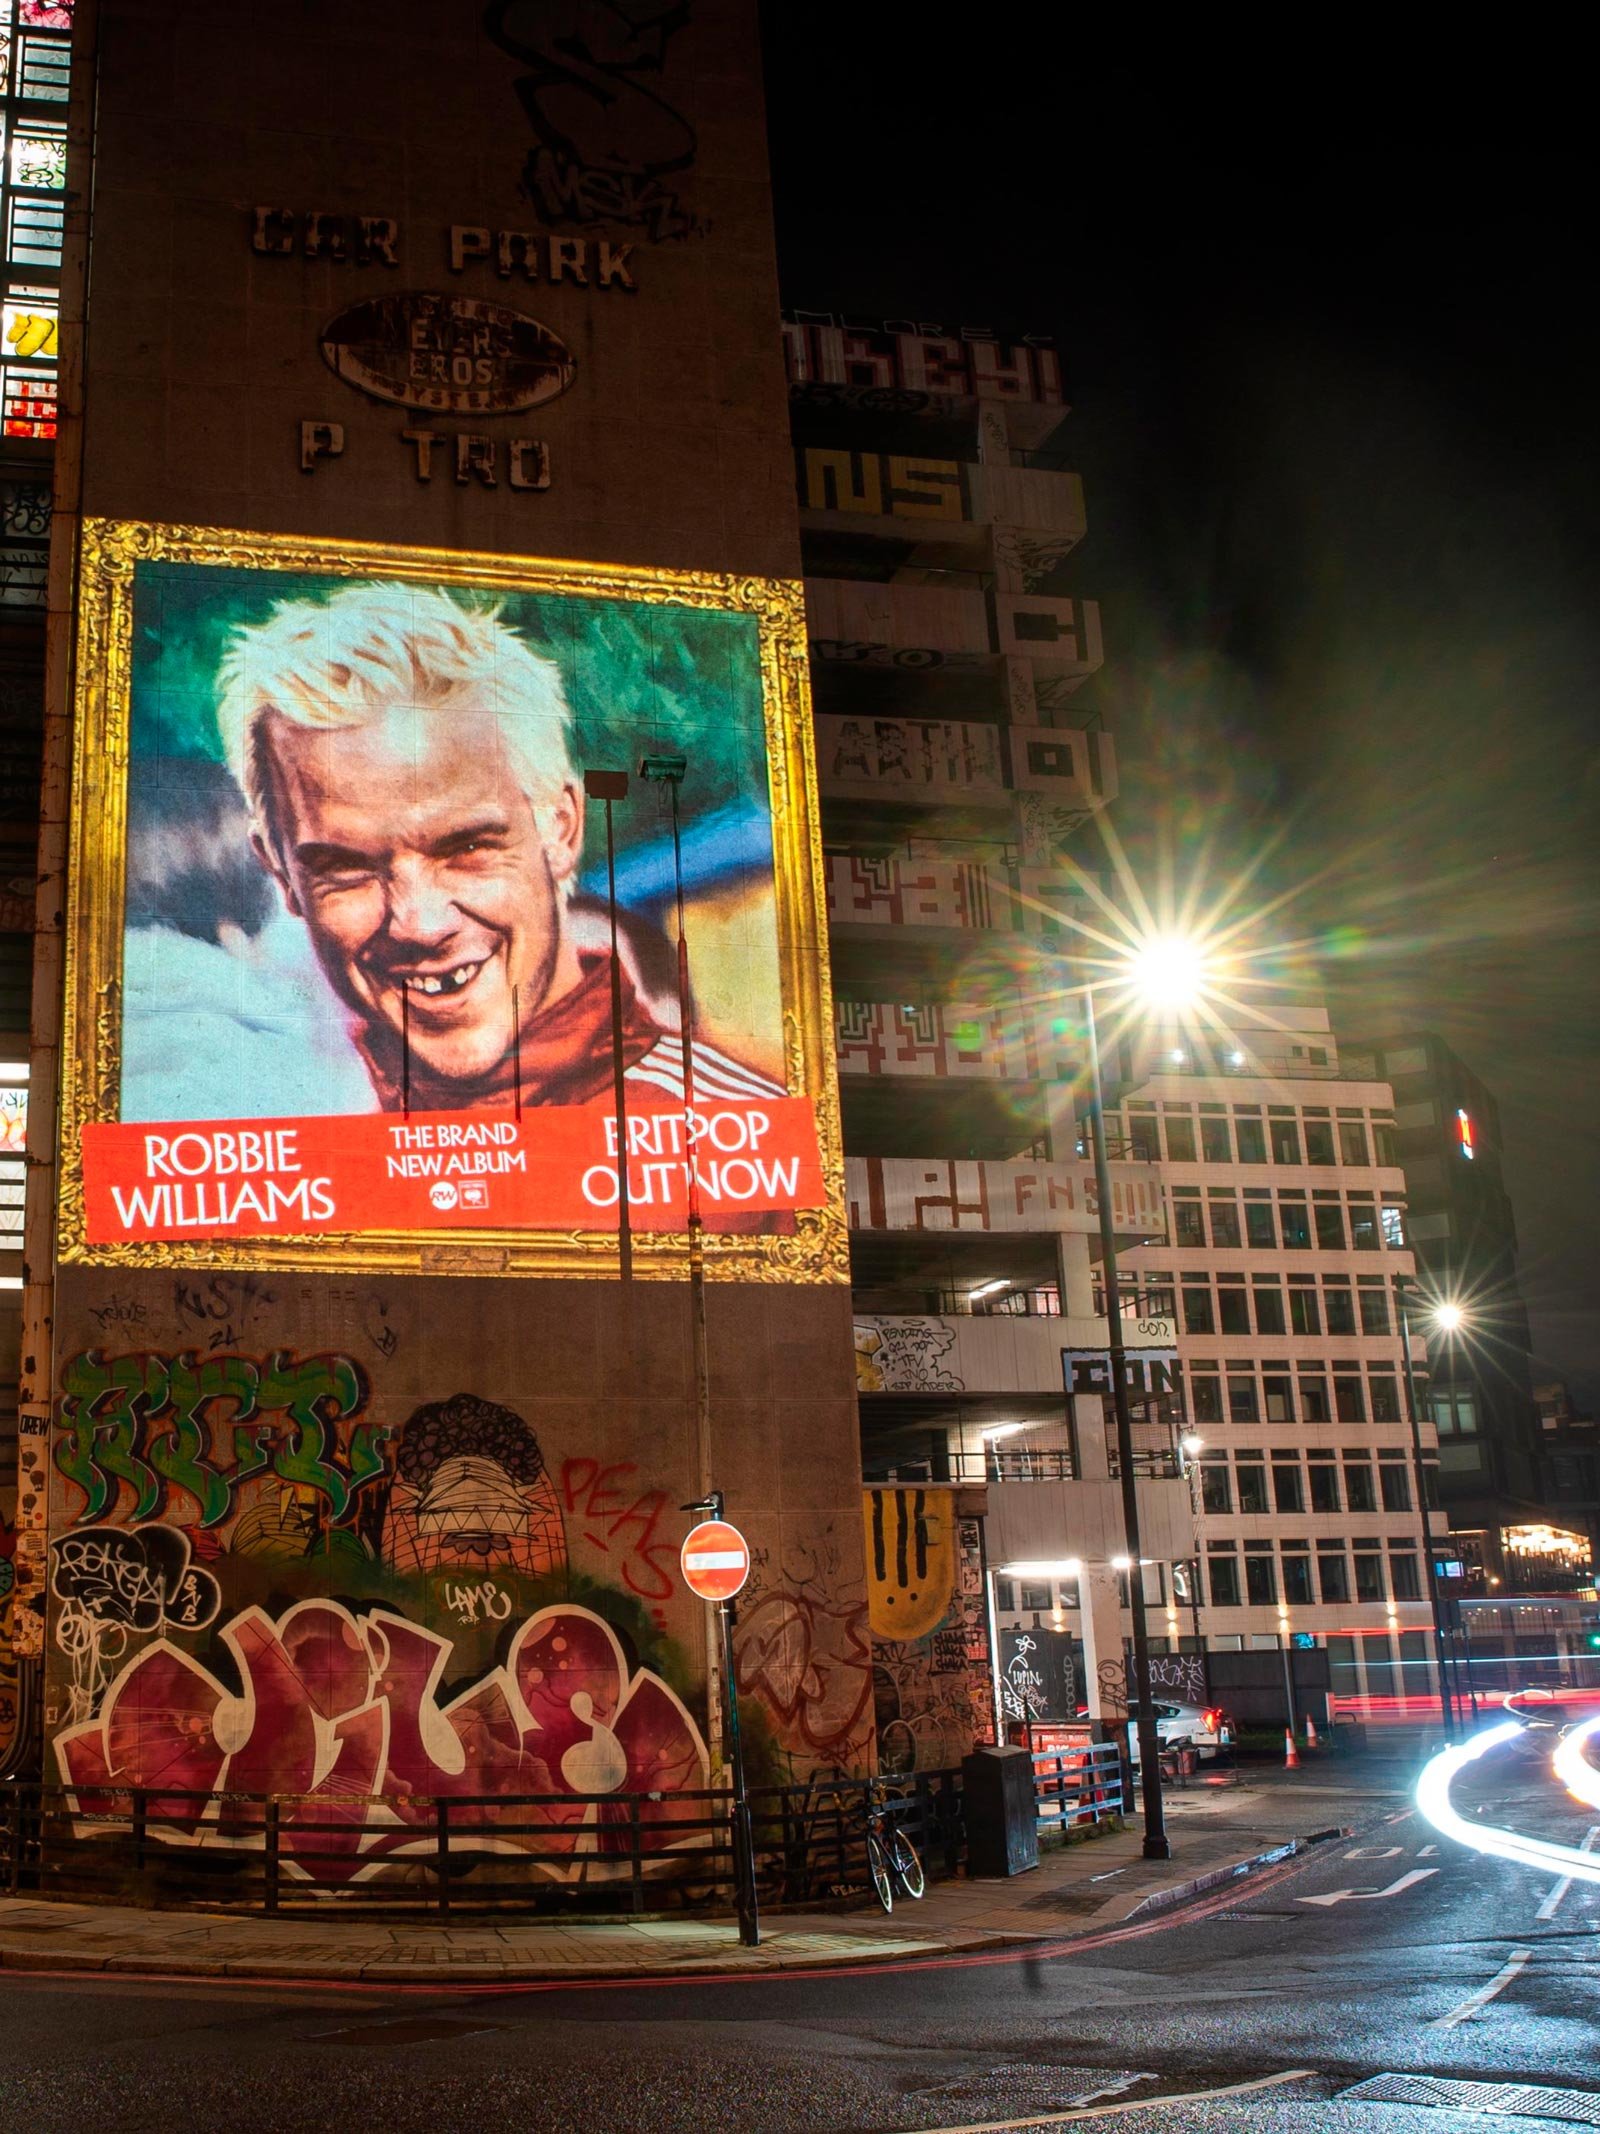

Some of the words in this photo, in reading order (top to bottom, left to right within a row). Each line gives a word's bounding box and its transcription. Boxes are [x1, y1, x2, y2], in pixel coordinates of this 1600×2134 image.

[253, 206, 399, 266] CAR
[449, 225, 638, 291] PARK
[144, 1130, 301, 1177] ROBBIE
[388, 1125, 434, 1148] THE
[436, 1122, 517, 1147] BRAND
[386, 1154, 442, 1177] NEW
[445, 1150, 526, 1175] ALBUM
[581, 1162, 676, 1207] OUT
[682, 1157, 800, 1201] NOW
[111, 1177, 336, 1228] WILLIAMS
[20, 1414, 50, 1438] DREW
[960, 1521, 979, 1549] DREW
